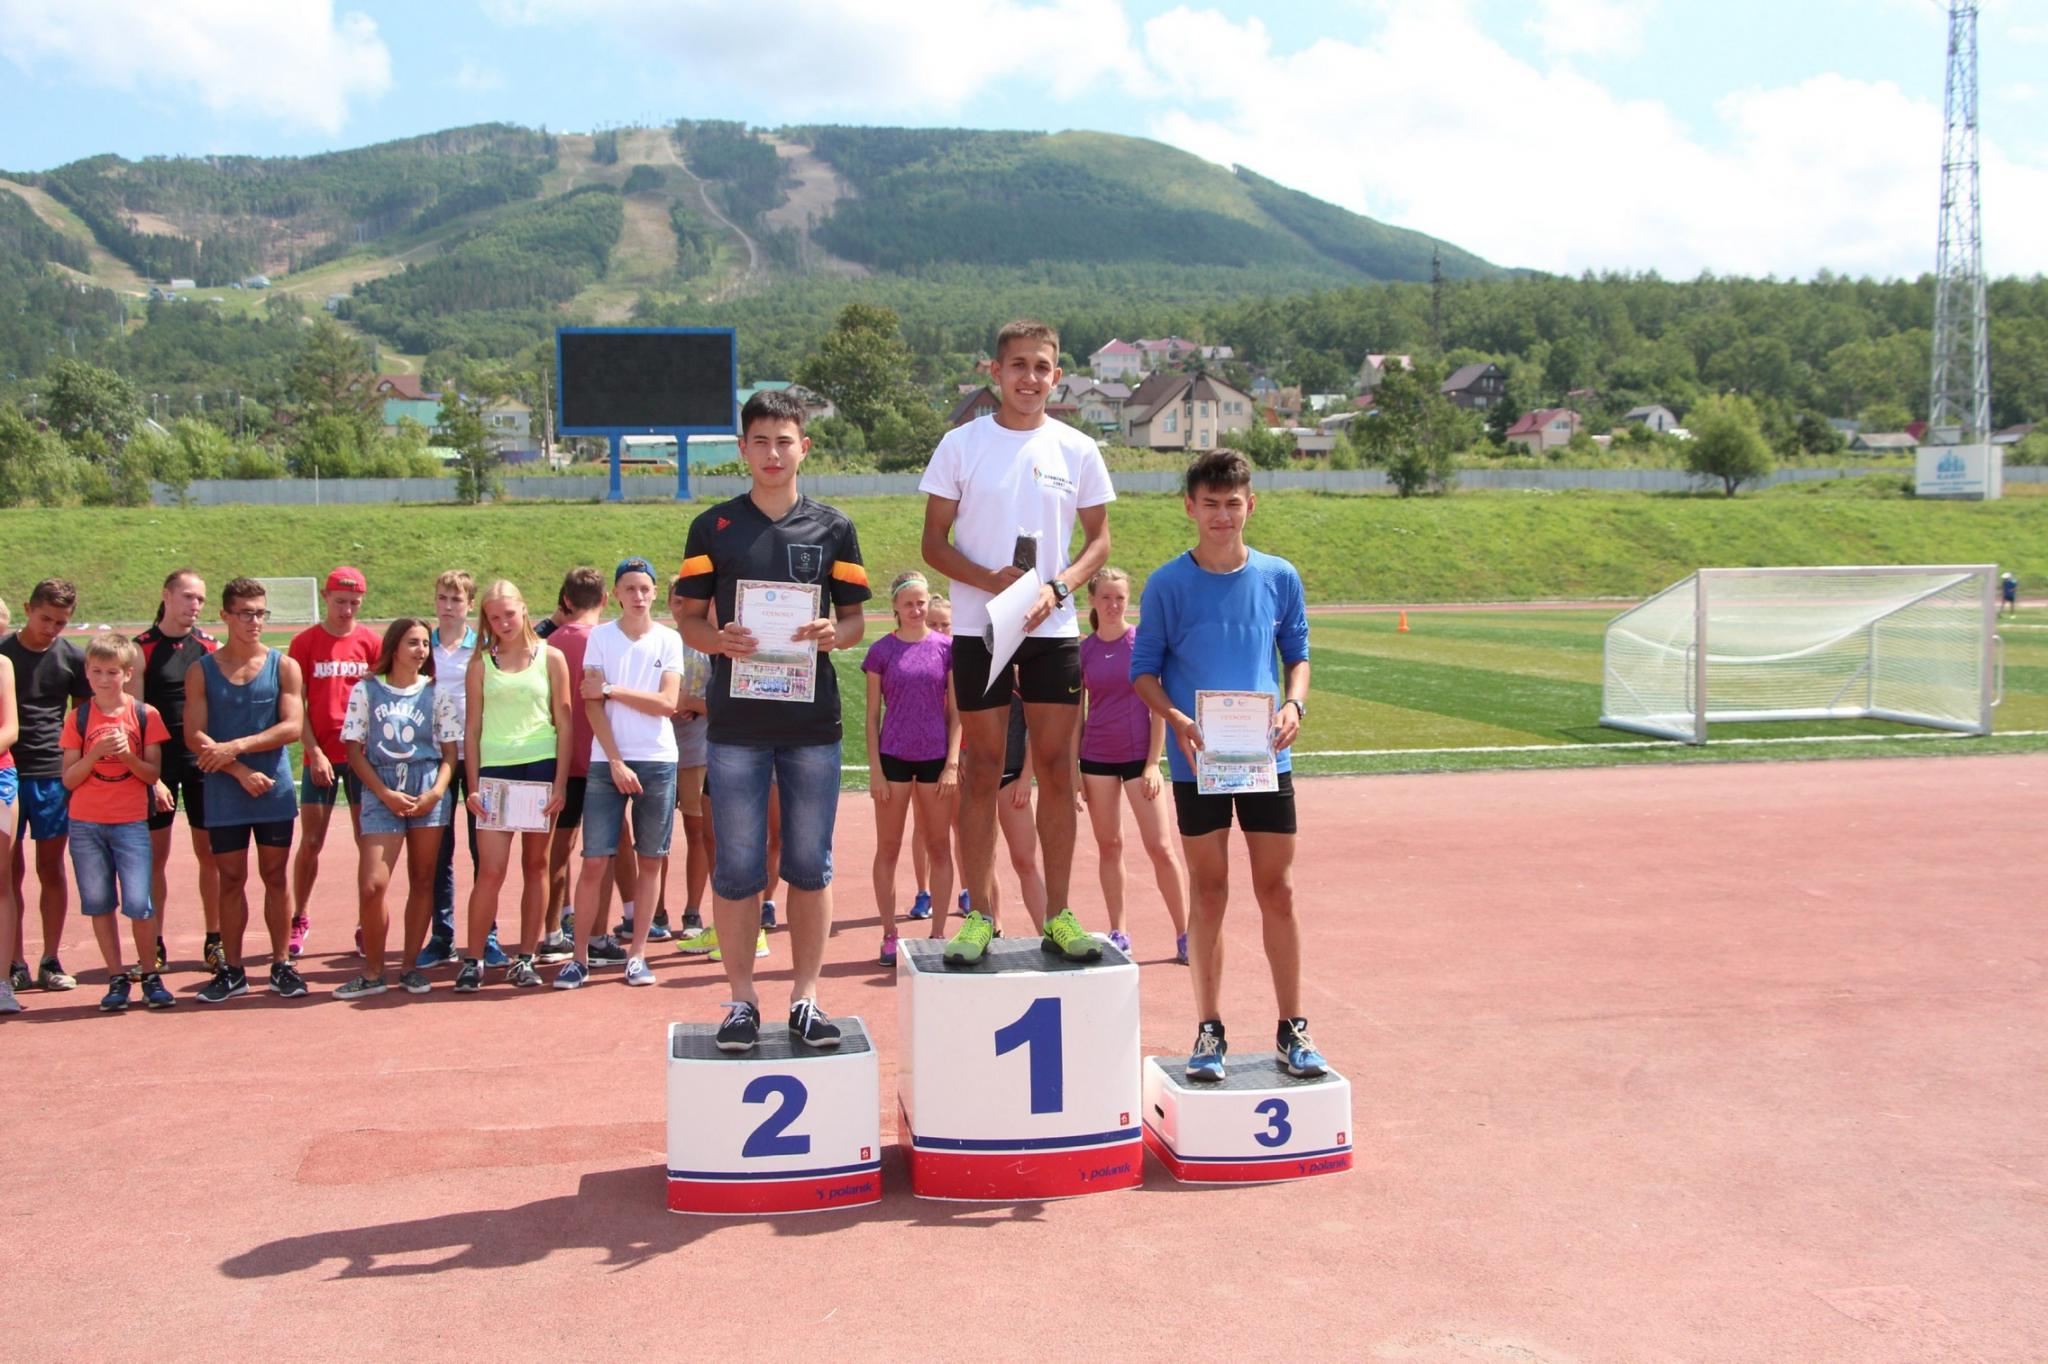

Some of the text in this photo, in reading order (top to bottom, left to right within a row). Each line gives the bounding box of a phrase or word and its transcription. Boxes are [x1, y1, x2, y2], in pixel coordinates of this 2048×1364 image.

[313, 661, 340, 678] JUST
[341, 661, 357, 676] DO
[994, 997, 1063, 1114] 1
[741, 1074, 811, 1158] 2
[1253, 1098, 1292, 1148] 3
[1089, 1162, 1131, 1181] polanik
[1309, 1157, 1347, 1174] polanik
[828, 1181, 872, 1200] polanik
